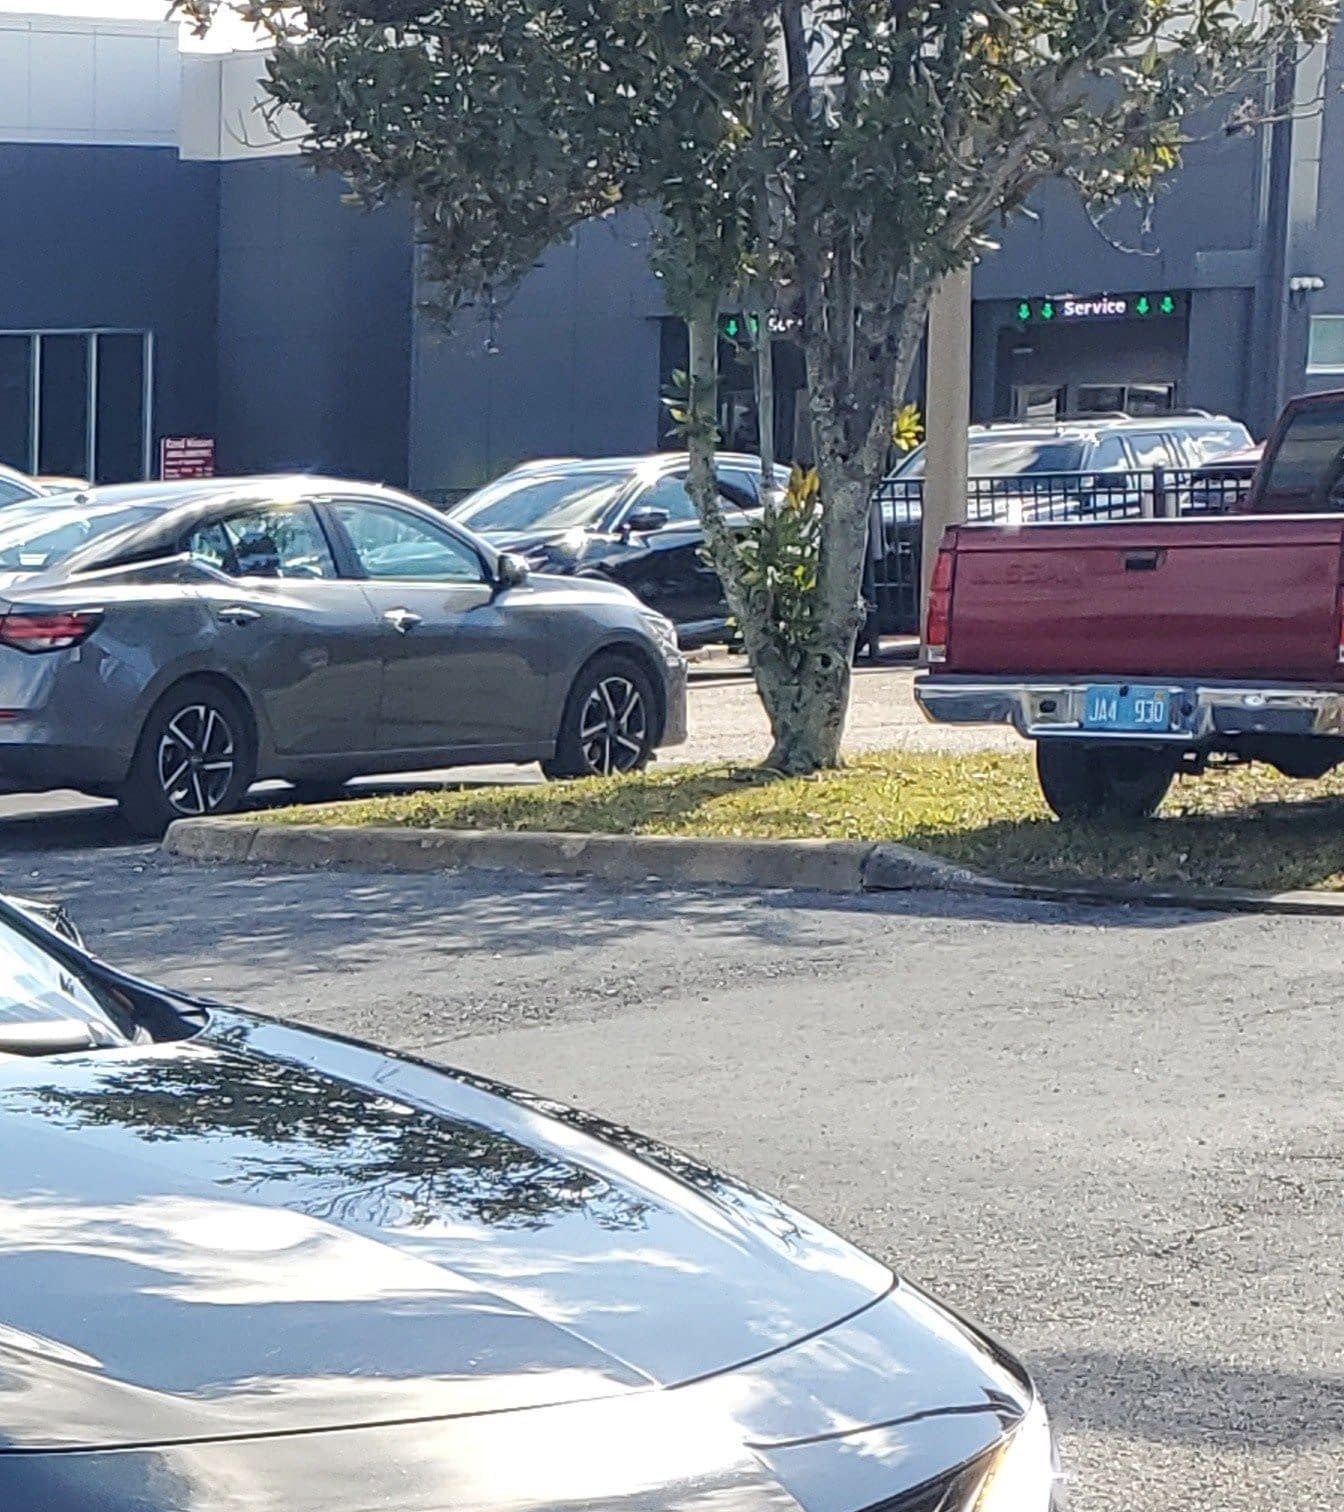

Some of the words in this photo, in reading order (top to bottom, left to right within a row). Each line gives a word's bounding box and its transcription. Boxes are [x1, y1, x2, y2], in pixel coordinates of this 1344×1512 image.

[1064, 298, 1126, 316] Service
[1088, 697, 1118, 722] JA4
[1135, 700, 1164, 723] 930
